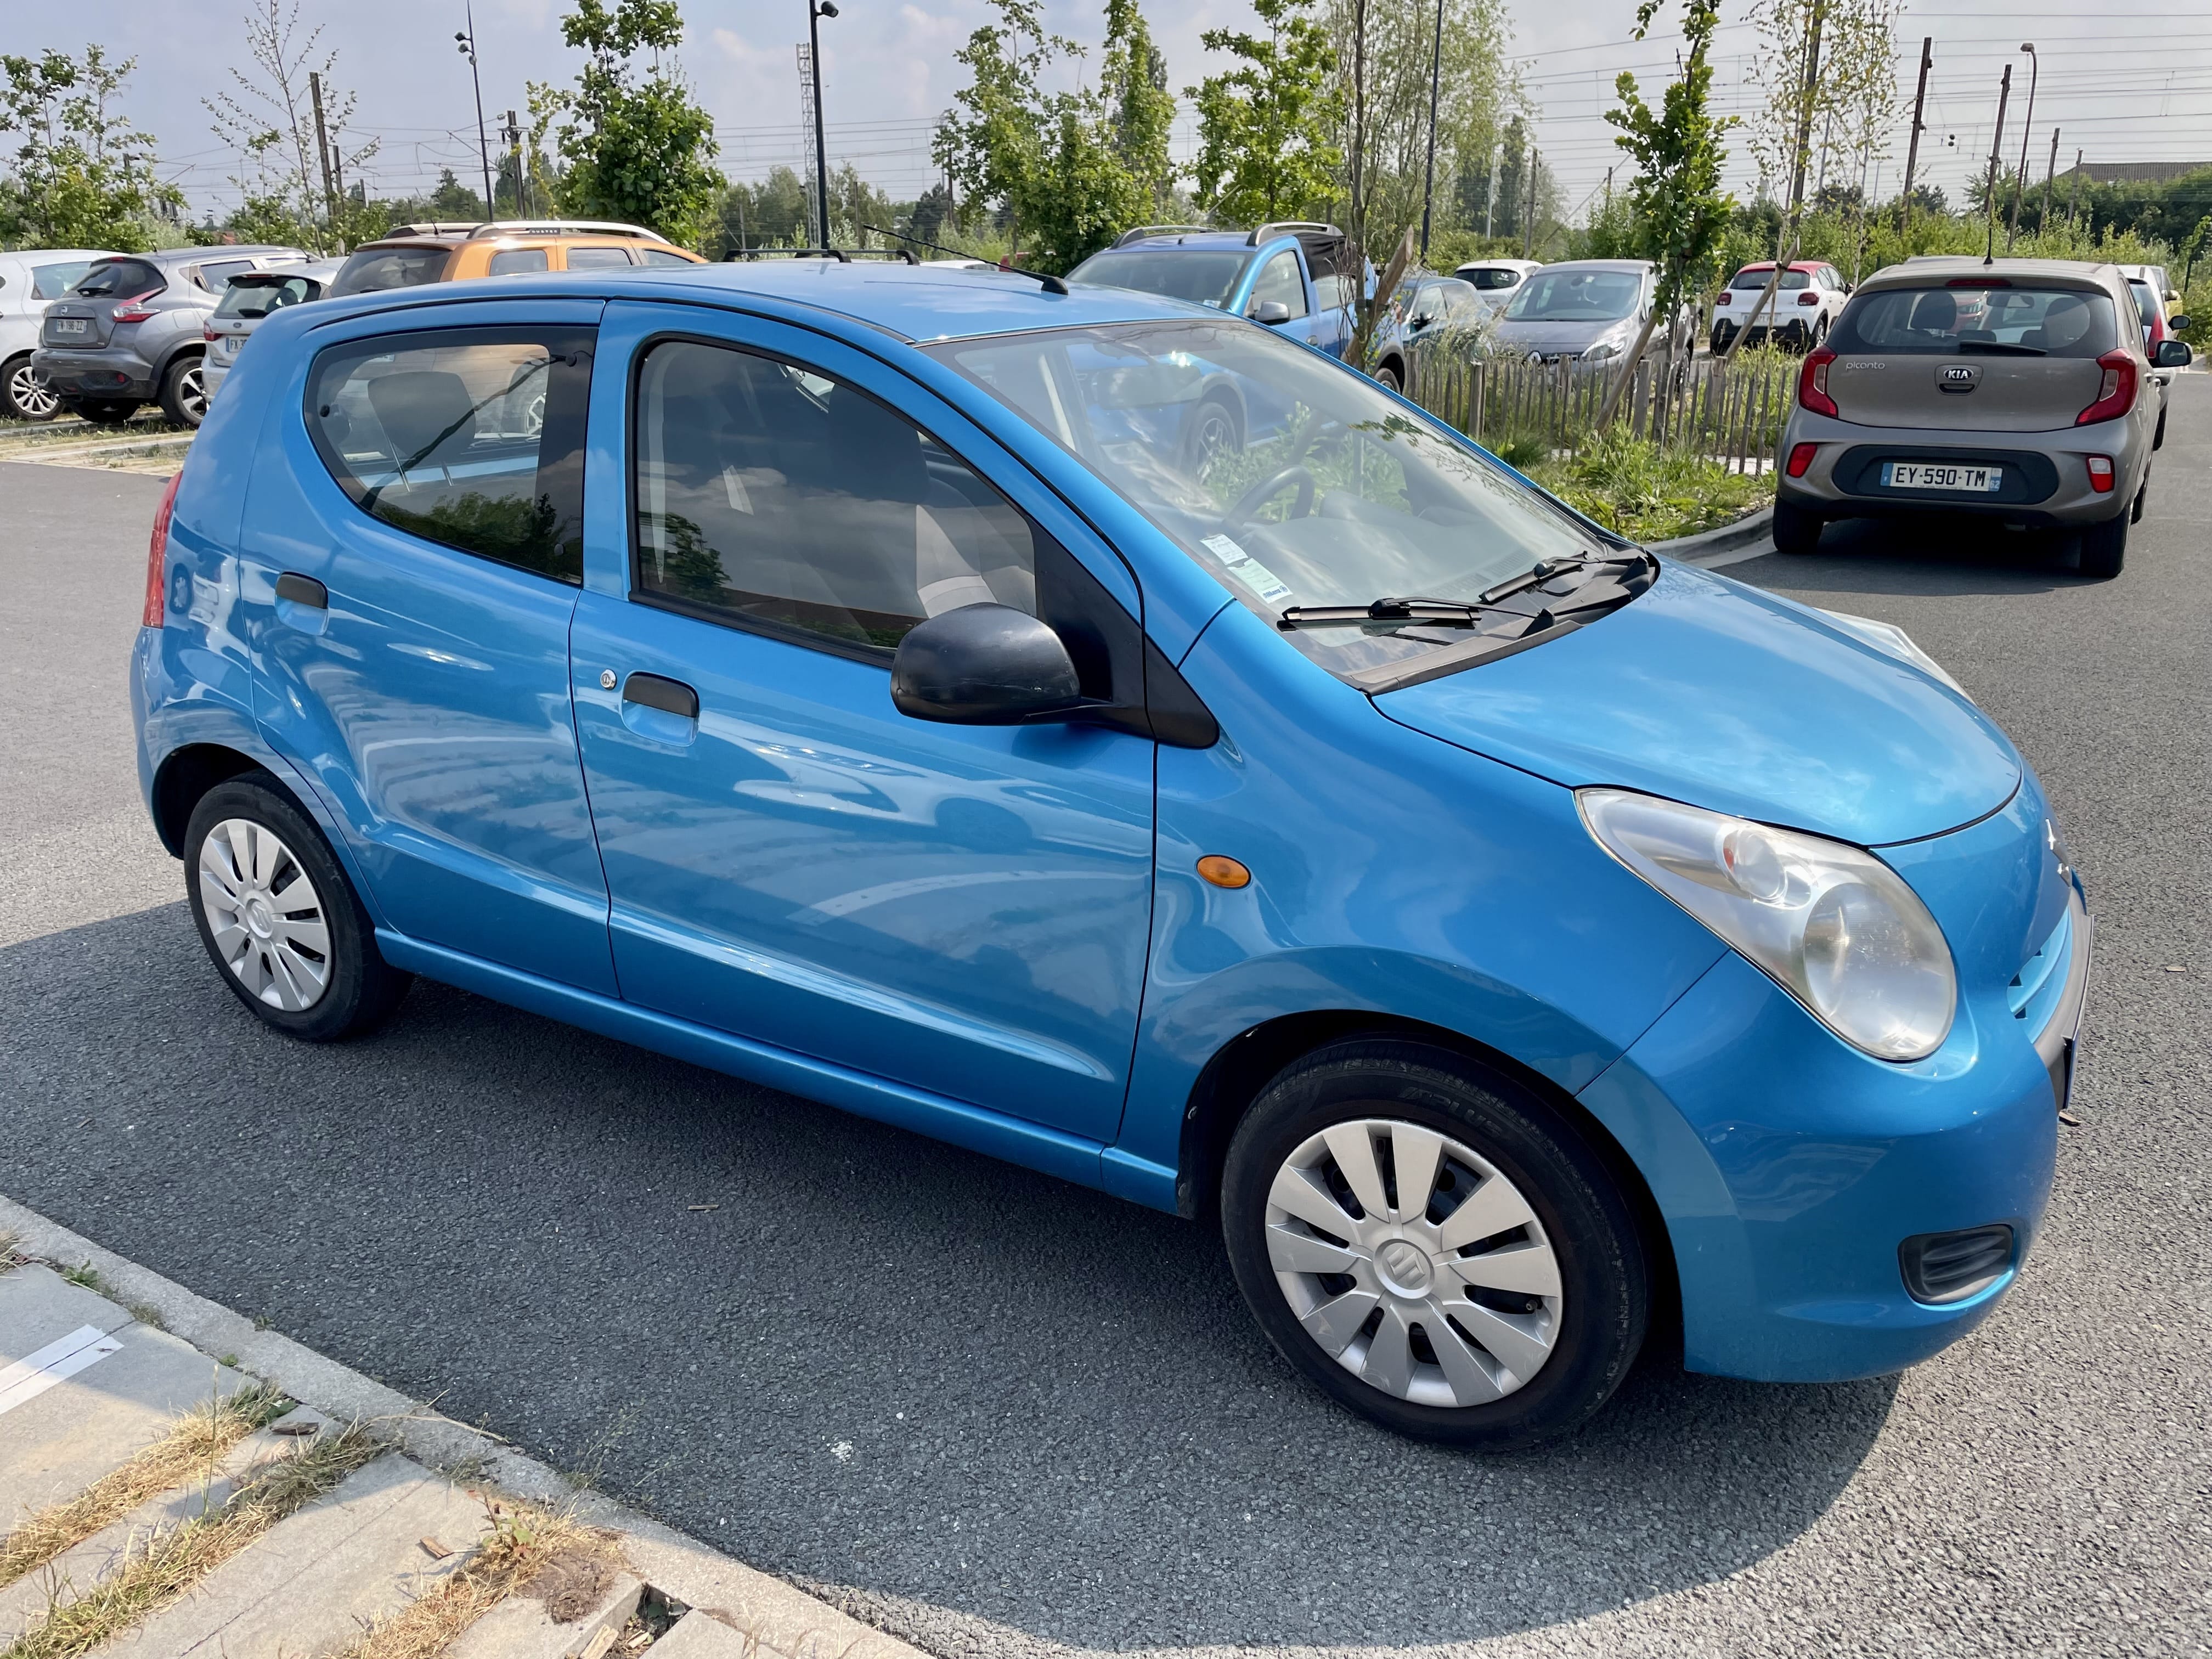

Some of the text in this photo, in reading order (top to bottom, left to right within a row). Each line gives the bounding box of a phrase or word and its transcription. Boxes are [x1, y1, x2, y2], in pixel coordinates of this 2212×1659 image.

[1846, 361, 1886, 371] picanto
[1948, 370, 1968, 379] KIA
[1895, 467, 1987, 487] EY-590-TM
[1989, 479, 2000, 489] 62
